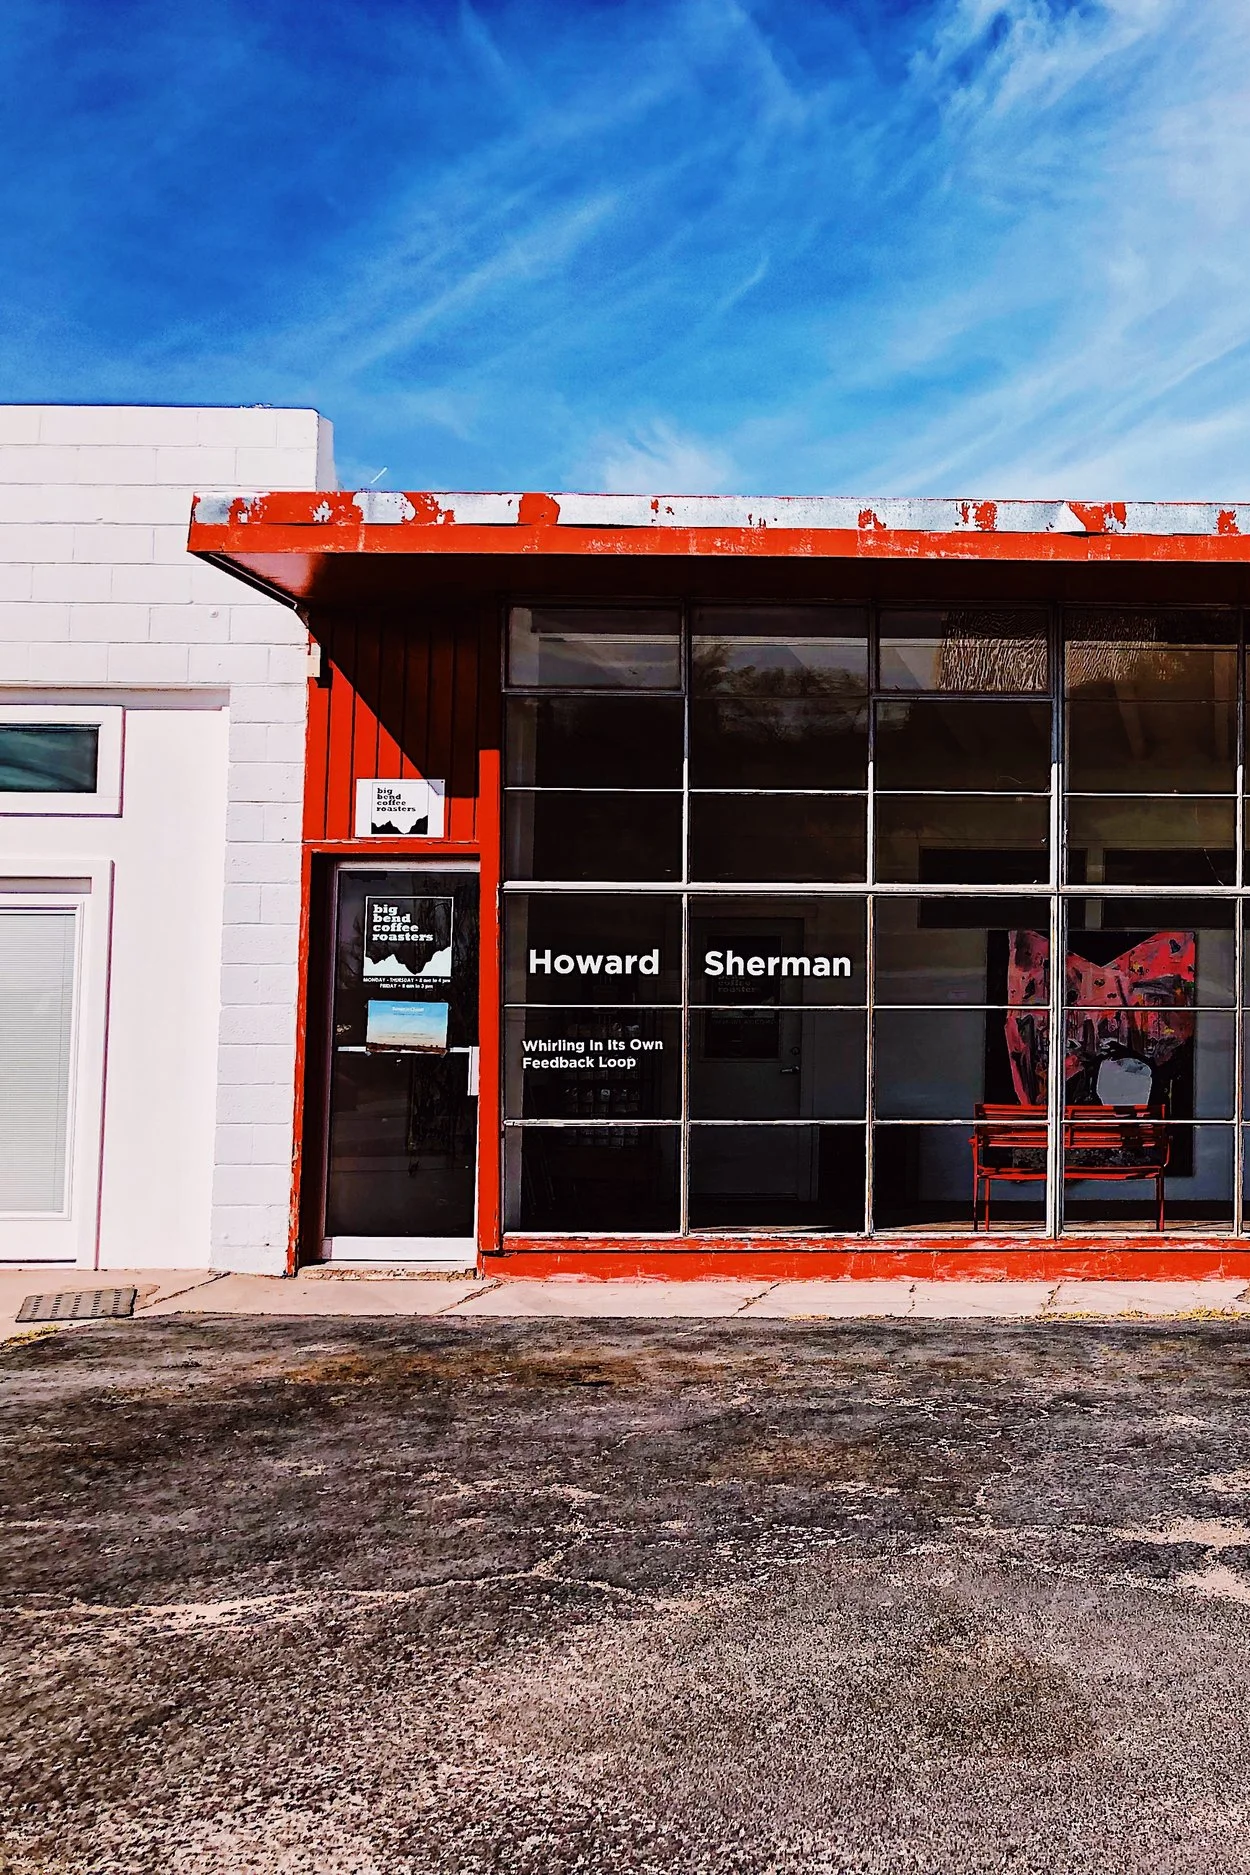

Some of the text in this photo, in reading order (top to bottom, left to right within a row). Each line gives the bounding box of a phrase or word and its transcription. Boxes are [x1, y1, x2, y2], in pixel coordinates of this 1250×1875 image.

[373, 904, 398, 915] big
[373, 914, 411, 923] bend
[373, 923, 419, 932] coffee
[372, 932, 434, 941] roasters
[529, 949, 851, 977] Howard Sherman
[522, 1039, 664, 1053] Whirling In Its Own
[522, 1056, 636, 1069] Feedback Loop
